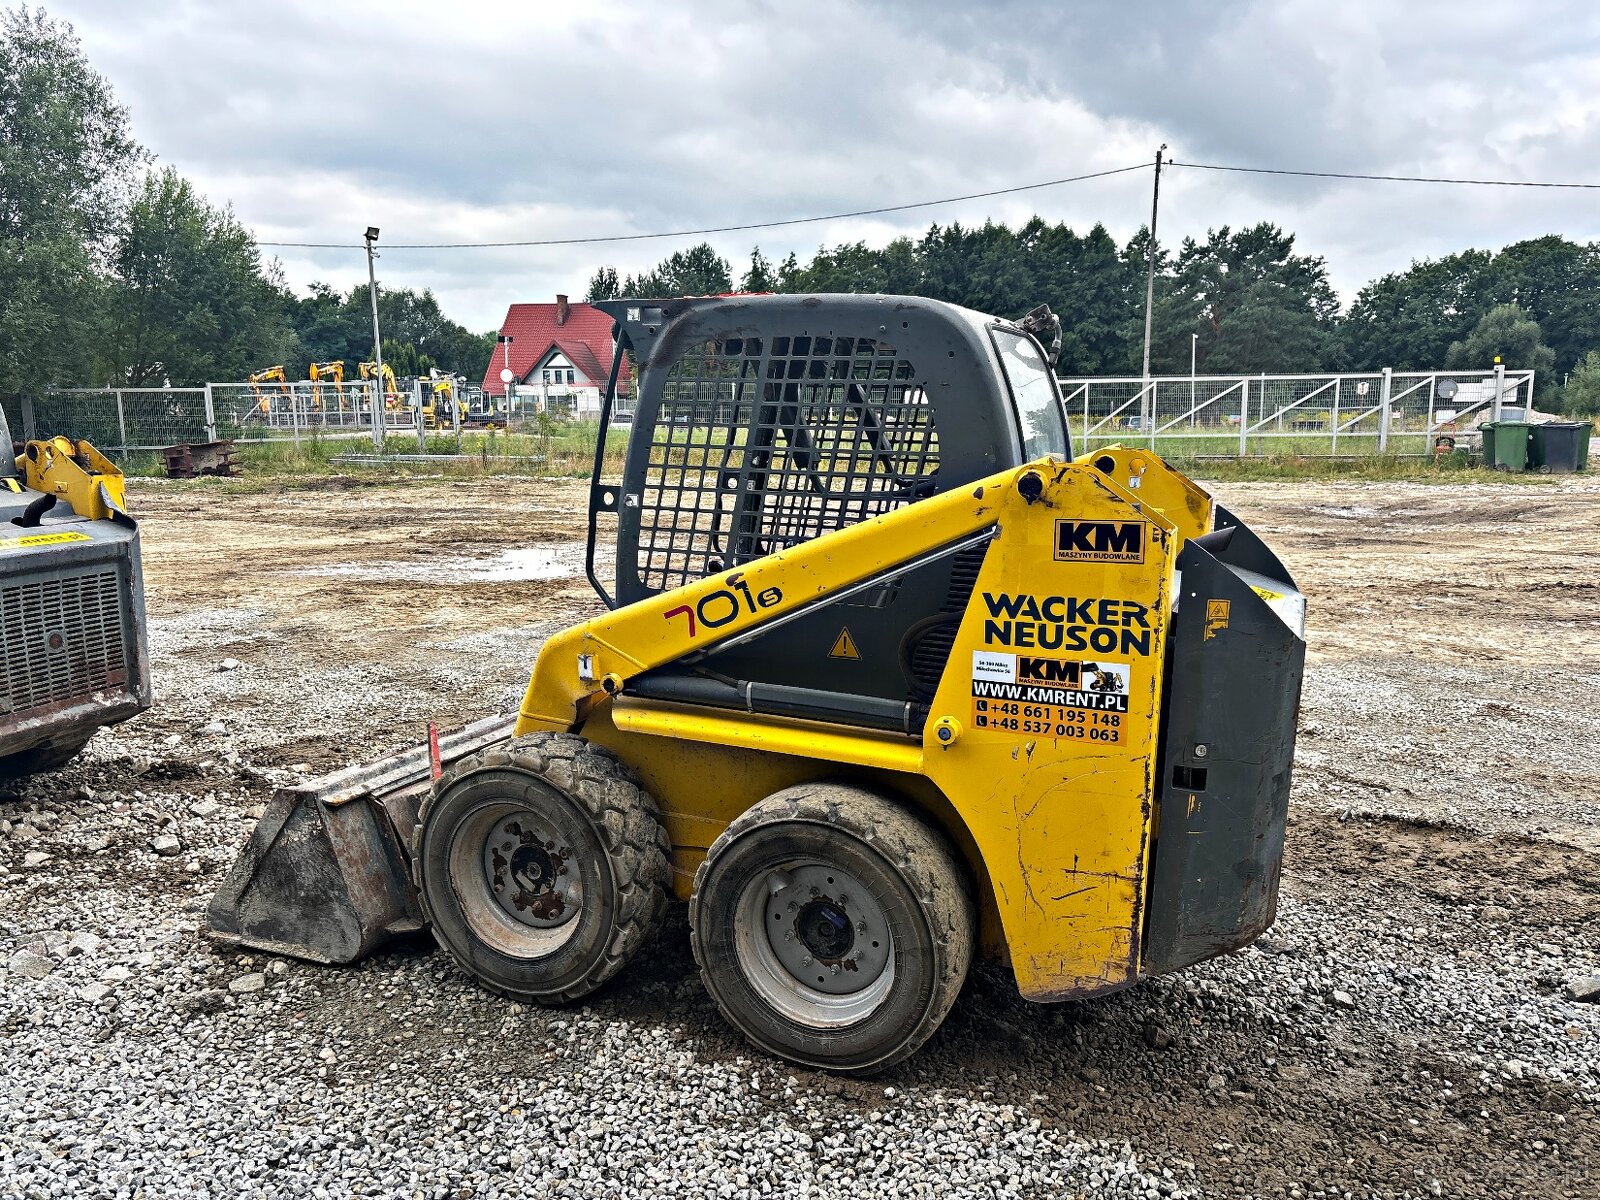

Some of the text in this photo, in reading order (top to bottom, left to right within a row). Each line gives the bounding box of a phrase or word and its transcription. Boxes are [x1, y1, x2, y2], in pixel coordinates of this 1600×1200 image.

[1059, 522, 1141, 553] KM
[1058, 551, 1140, 561] MASZYNY BUDOWLANE
[982, 592, 1151, 629] WACKER
[984, 619, 1151, 657] NEUSON
[1019, 657, 1080, 683] KM
[973, 681, 1126, 711] WWW.KMRENT.PL
[1018, 678, 1079, 689] MASZYNY BUDOWLANE
[991, 702, 1121, 727] +48 661 195 148
[990, 717, 1119, 742] +48 537 003 063
